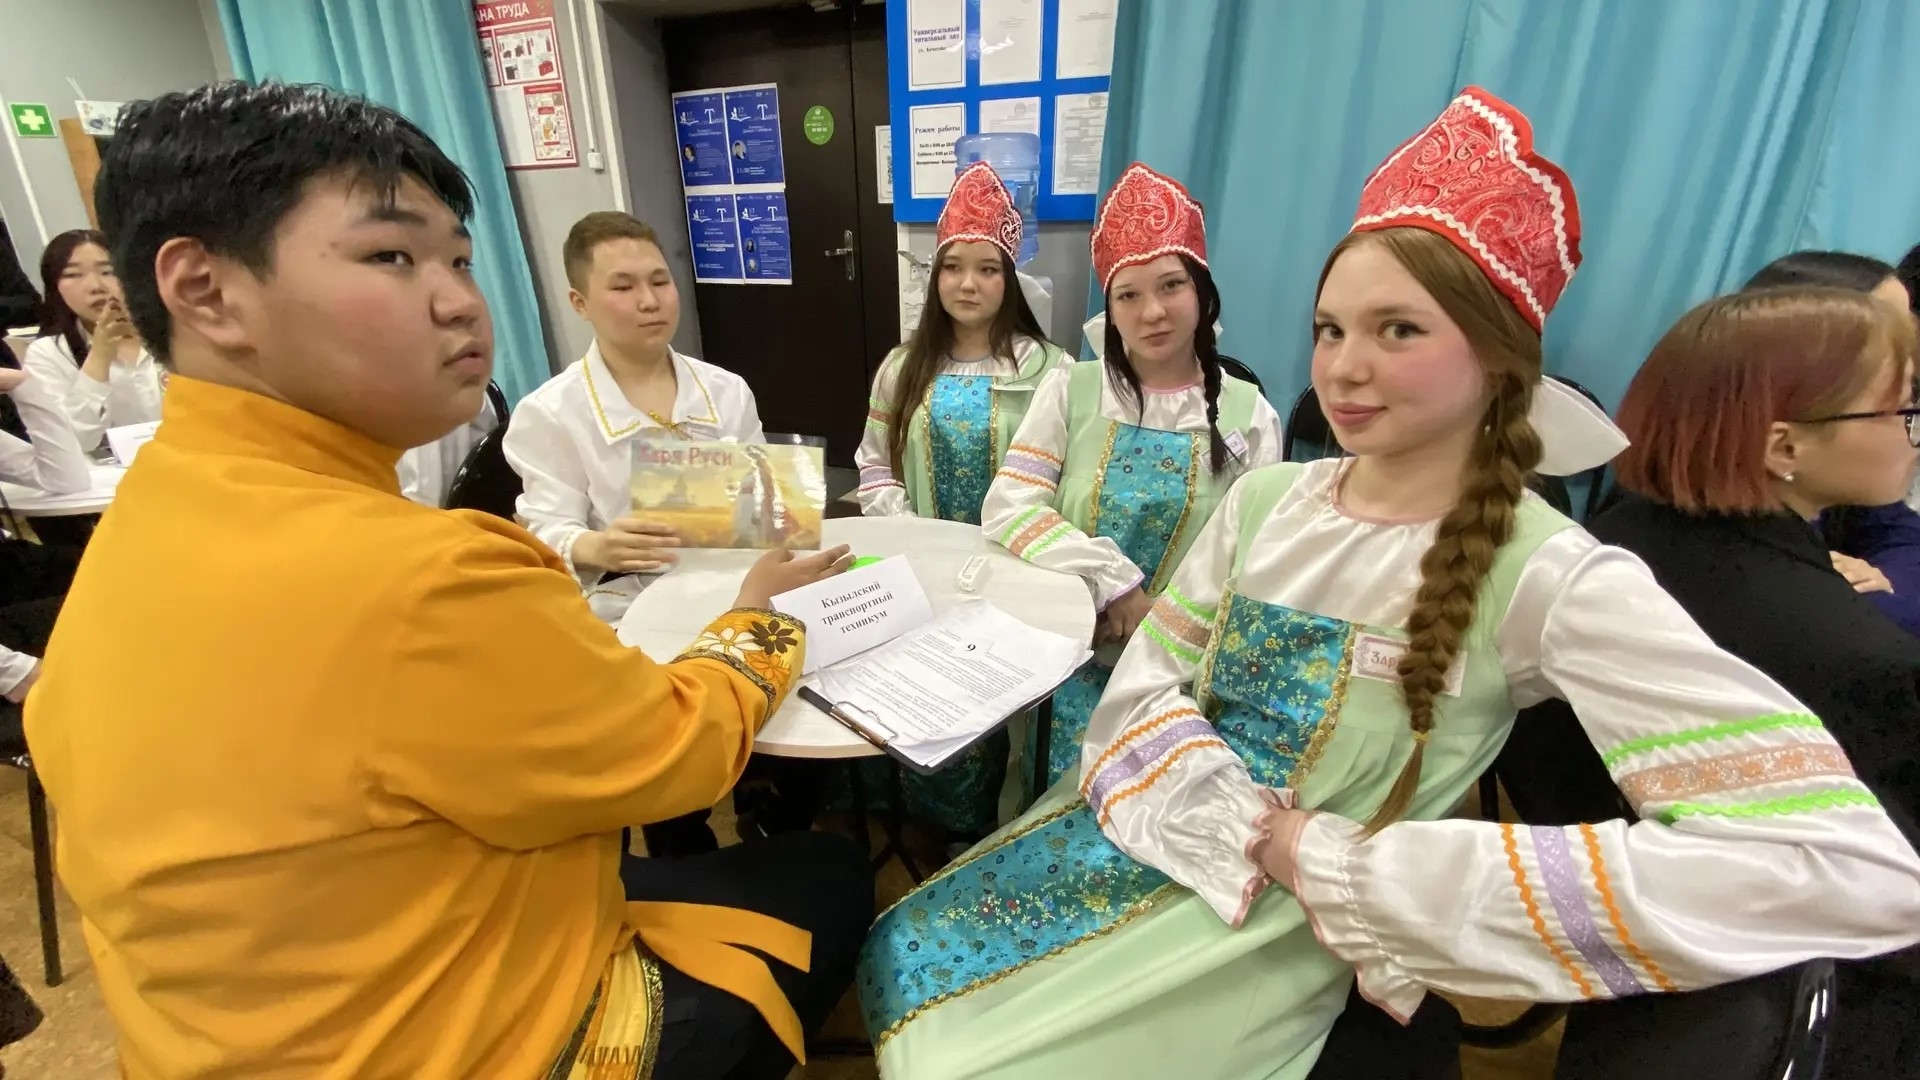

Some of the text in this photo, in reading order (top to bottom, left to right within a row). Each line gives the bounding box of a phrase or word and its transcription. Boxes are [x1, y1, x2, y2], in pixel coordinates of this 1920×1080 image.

[478, 2, 530, 22] НА ТРУДА
[820, 581, 881, 609] Кызылский
[820, 591, 893, 627] транспортный
[839, 610, 888, 635] техникум
